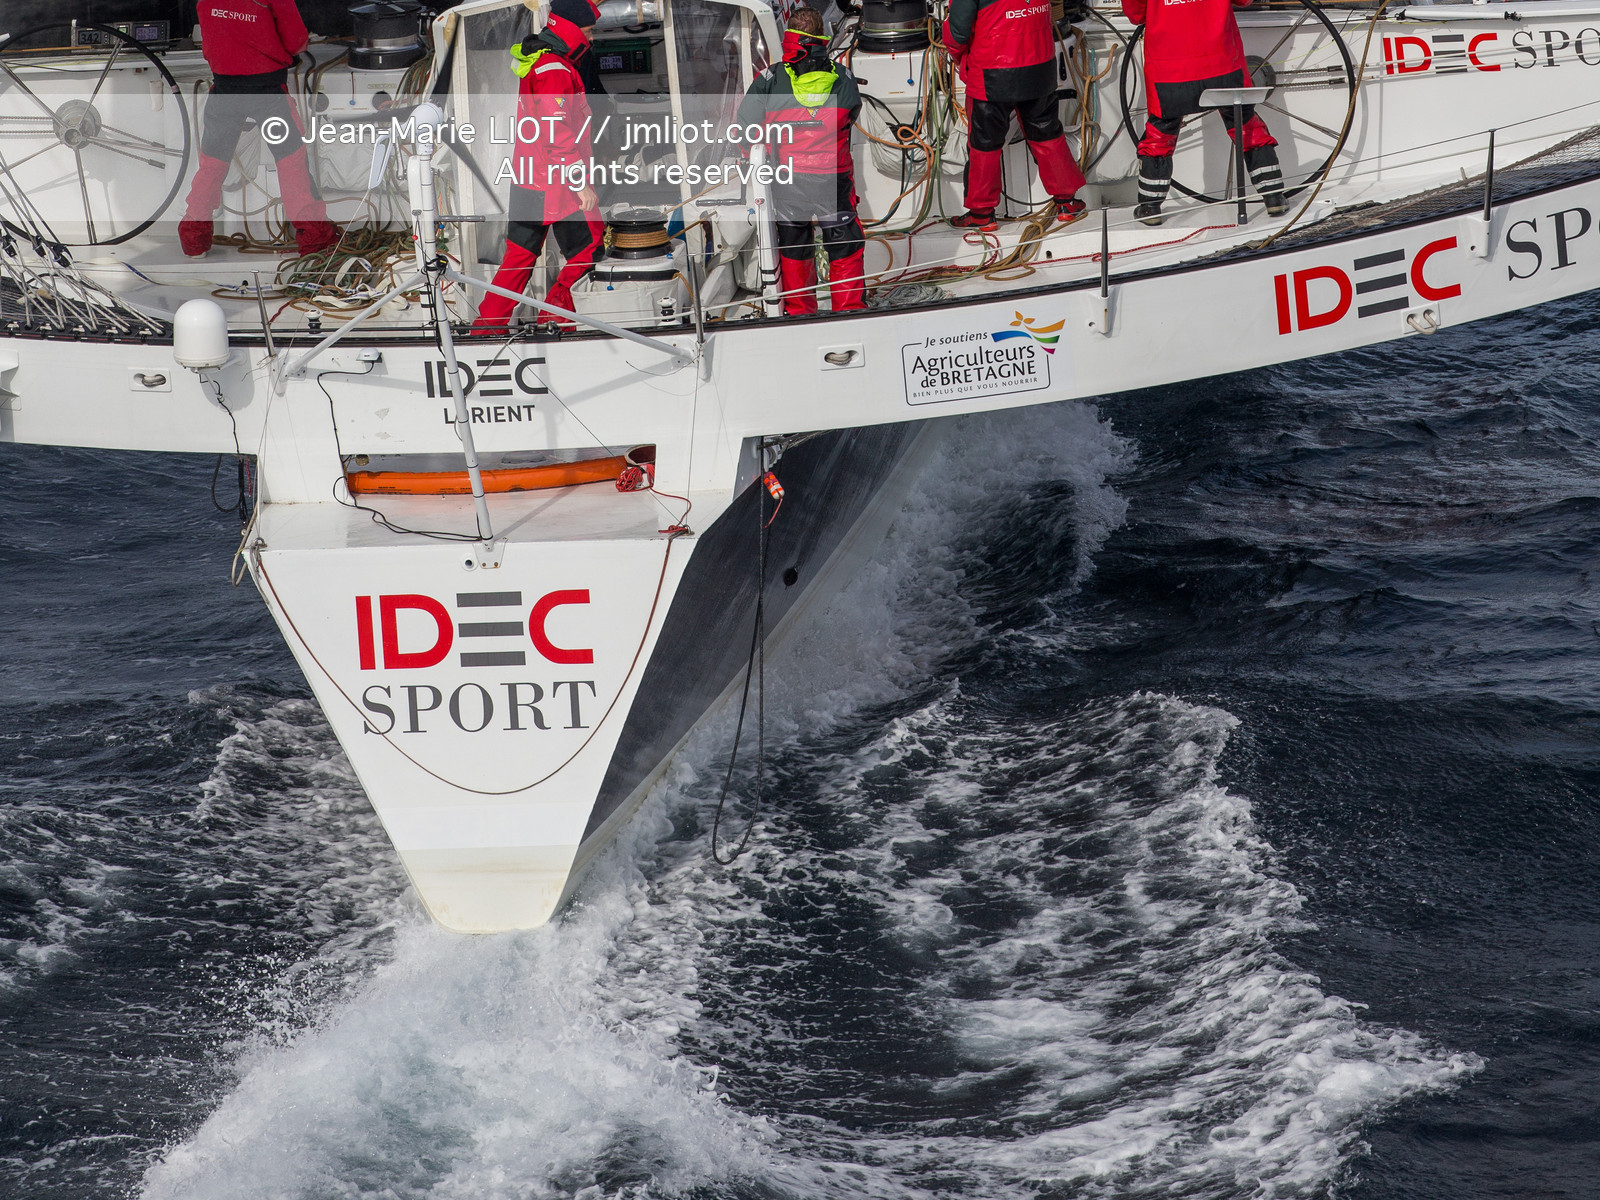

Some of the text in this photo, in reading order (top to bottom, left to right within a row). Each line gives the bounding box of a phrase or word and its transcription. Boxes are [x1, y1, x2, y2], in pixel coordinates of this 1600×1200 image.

[211, 8, 258, 23] IDEC SPORT
[1005, 3, 1050, 20] IDEC SPORT
[1383, 32, 1501, 75] IDEC
[1274, 206, 1600, 336] IDEC SP
[924, 331, 989, 349] Je soutiens
[911, 345, 1036, 377] Agriculteurs
[920, 360, 1037, 388] de BRETAGNE
[424, 357, 549, 399] IDEC
[912, 390, 931, 398] BIEN
[934, 387, 954, 396] PLUS
[977, 382, 999, 390] VOUS
[1001, 377, 1039, 387] NOURRIR
[443, 404, 536, 425] LRIENT
[355, 589, 594, 670] IDEC
[362, 680, 597, 735] SPORT
